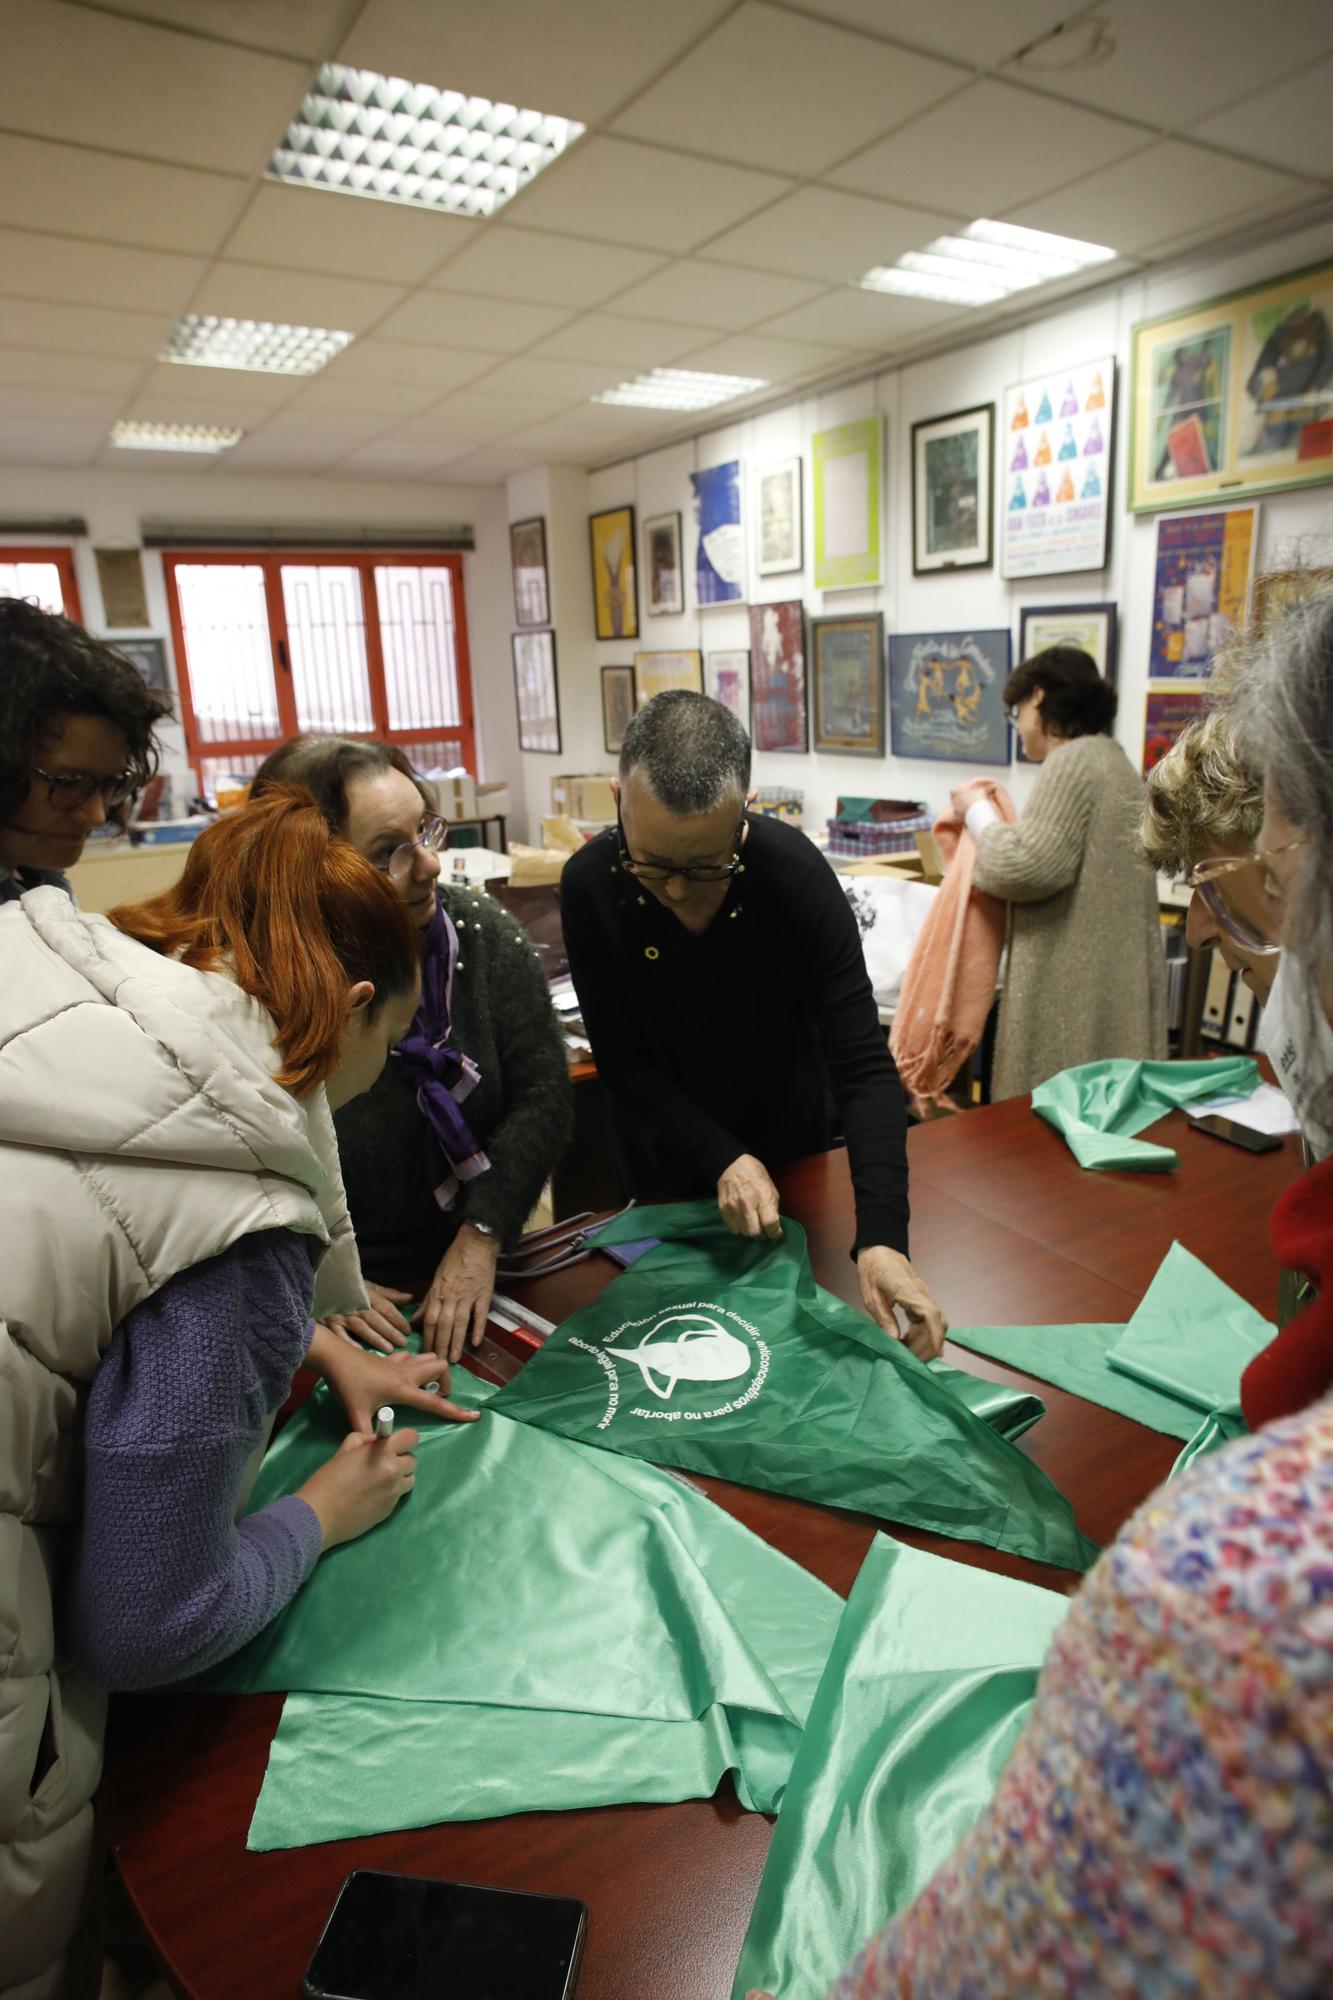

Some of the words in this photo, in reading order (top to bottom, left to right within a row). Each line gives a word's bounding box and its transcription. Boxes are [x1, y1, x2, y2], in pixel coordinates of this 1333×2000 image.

[697, 1302, 726, 1315] para
[726, 1311, 761, 1341] decidir,
[568, 1336, 600, 1355] aborto
[604, 1369, 619, 1391] pra
[732, 1340, 772, 1410] anticonceptivos
[608, 1393, 619, 1406] no
[596, 1406, 618, 1430] morir
[629, 1407, 682, 1422] abortar
[683, 1411, 702, 1420] no
[703, 1402, 734, 1419] para
